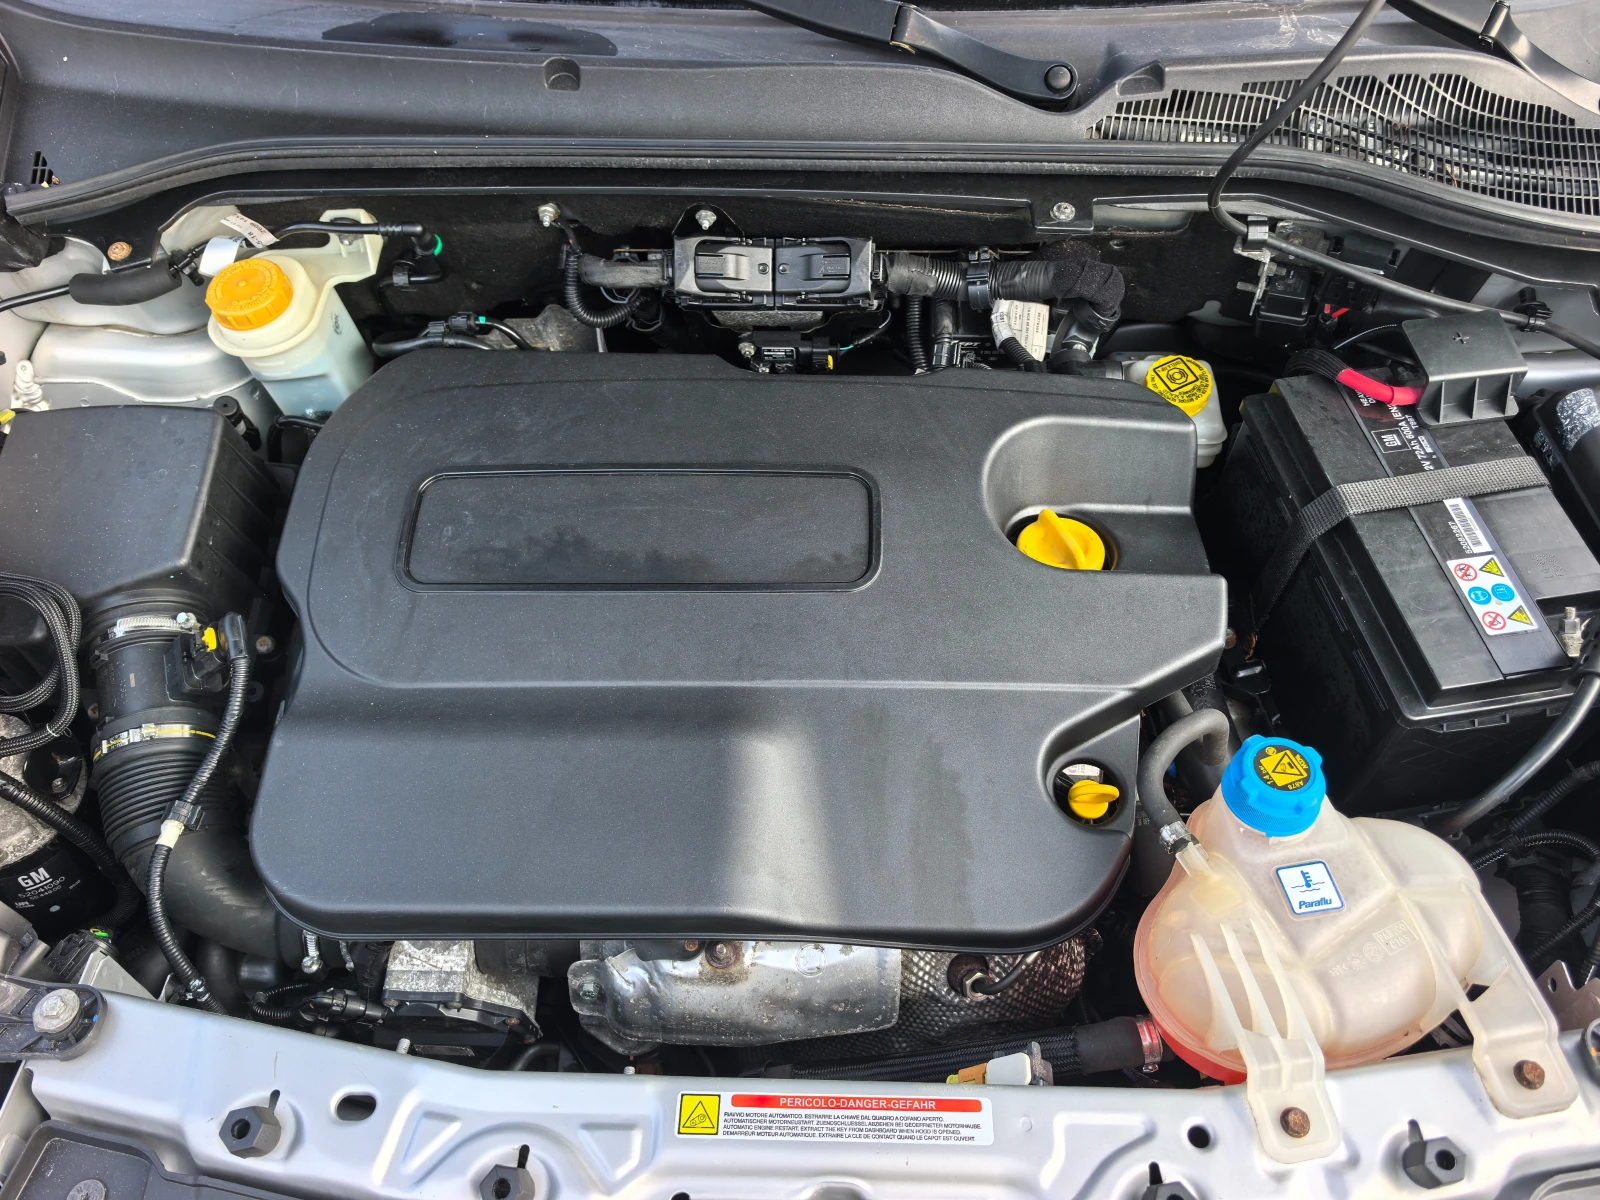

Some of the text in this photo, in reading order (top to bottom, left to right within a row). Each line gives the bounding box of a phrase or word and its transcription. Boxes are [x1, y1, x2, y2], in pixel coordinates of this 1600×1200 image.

[1398, 421, 1415, 440] 600A
[1381, 434, 1399, 447] GM
[1410, 440, 1428, 460] 72Ah
[17, 867, 51, 888] GM
[1299, 897, 1332, 909] Paraflu
[779, 1097, 936, 1110] PERICOLO-DANGER-GEFAHR
